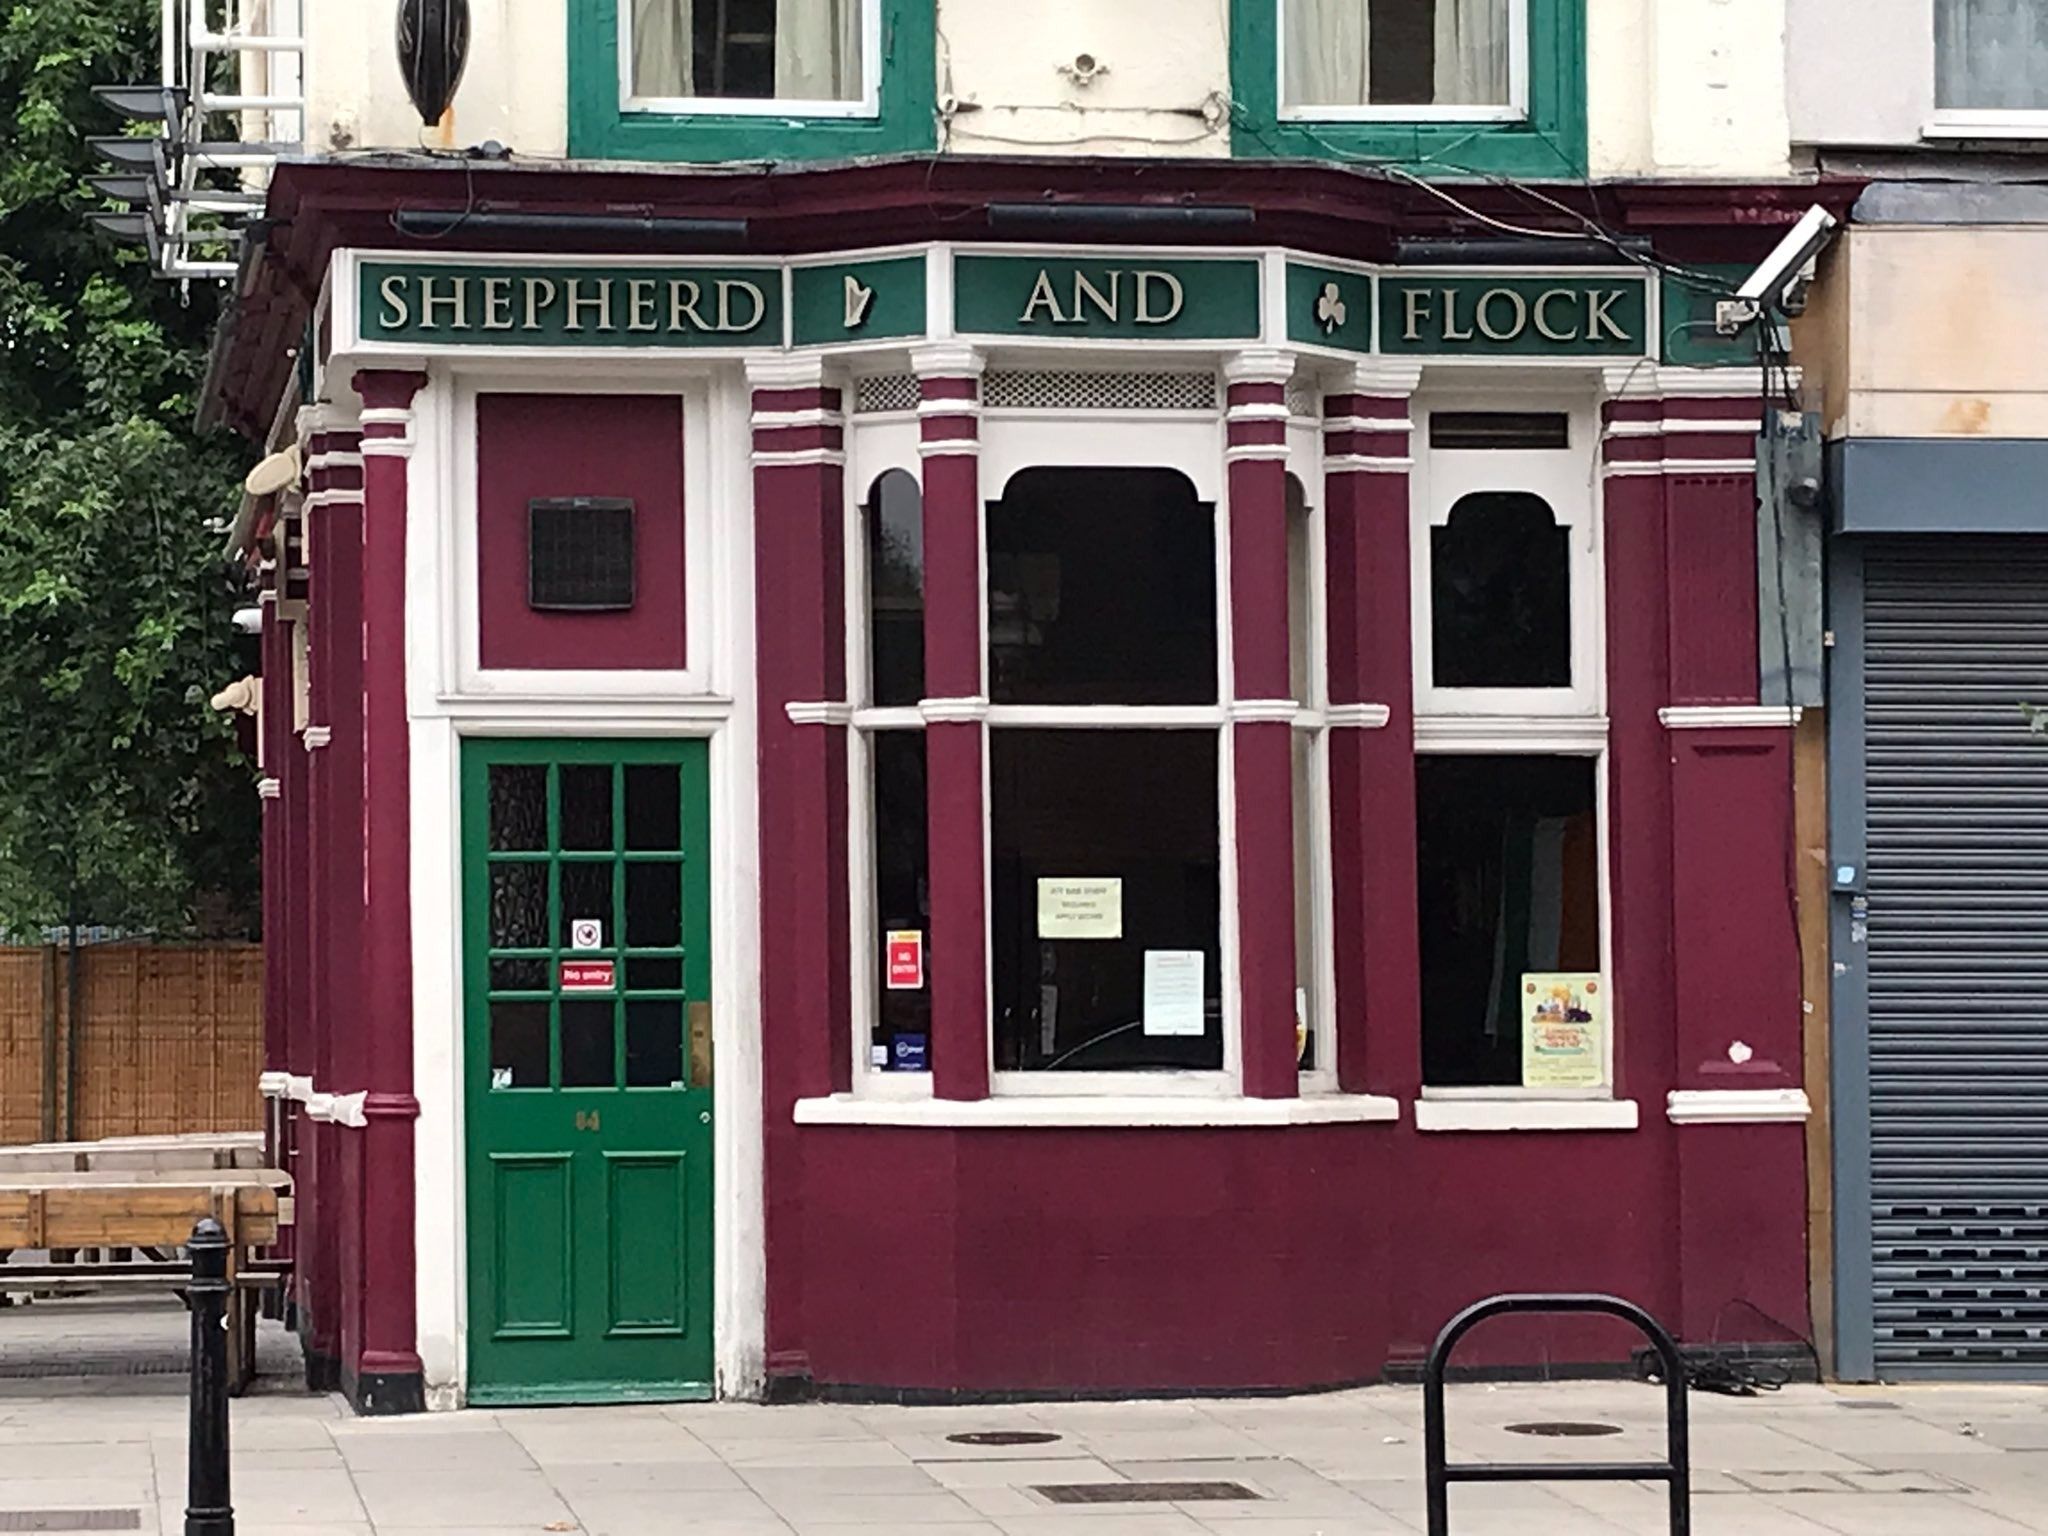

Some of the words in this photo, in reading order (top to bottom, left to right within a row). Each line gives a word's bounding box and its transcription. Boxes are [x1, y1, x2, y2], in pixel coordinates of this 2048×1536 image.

[379, 276, 765, 332] SHEPHERD
[1018, 269, 1184, 324] AND
[1402, 288, 1632, 341] FLOCK
[563, 969, 580, 981] No
[582, 970, 612, 982] entry
